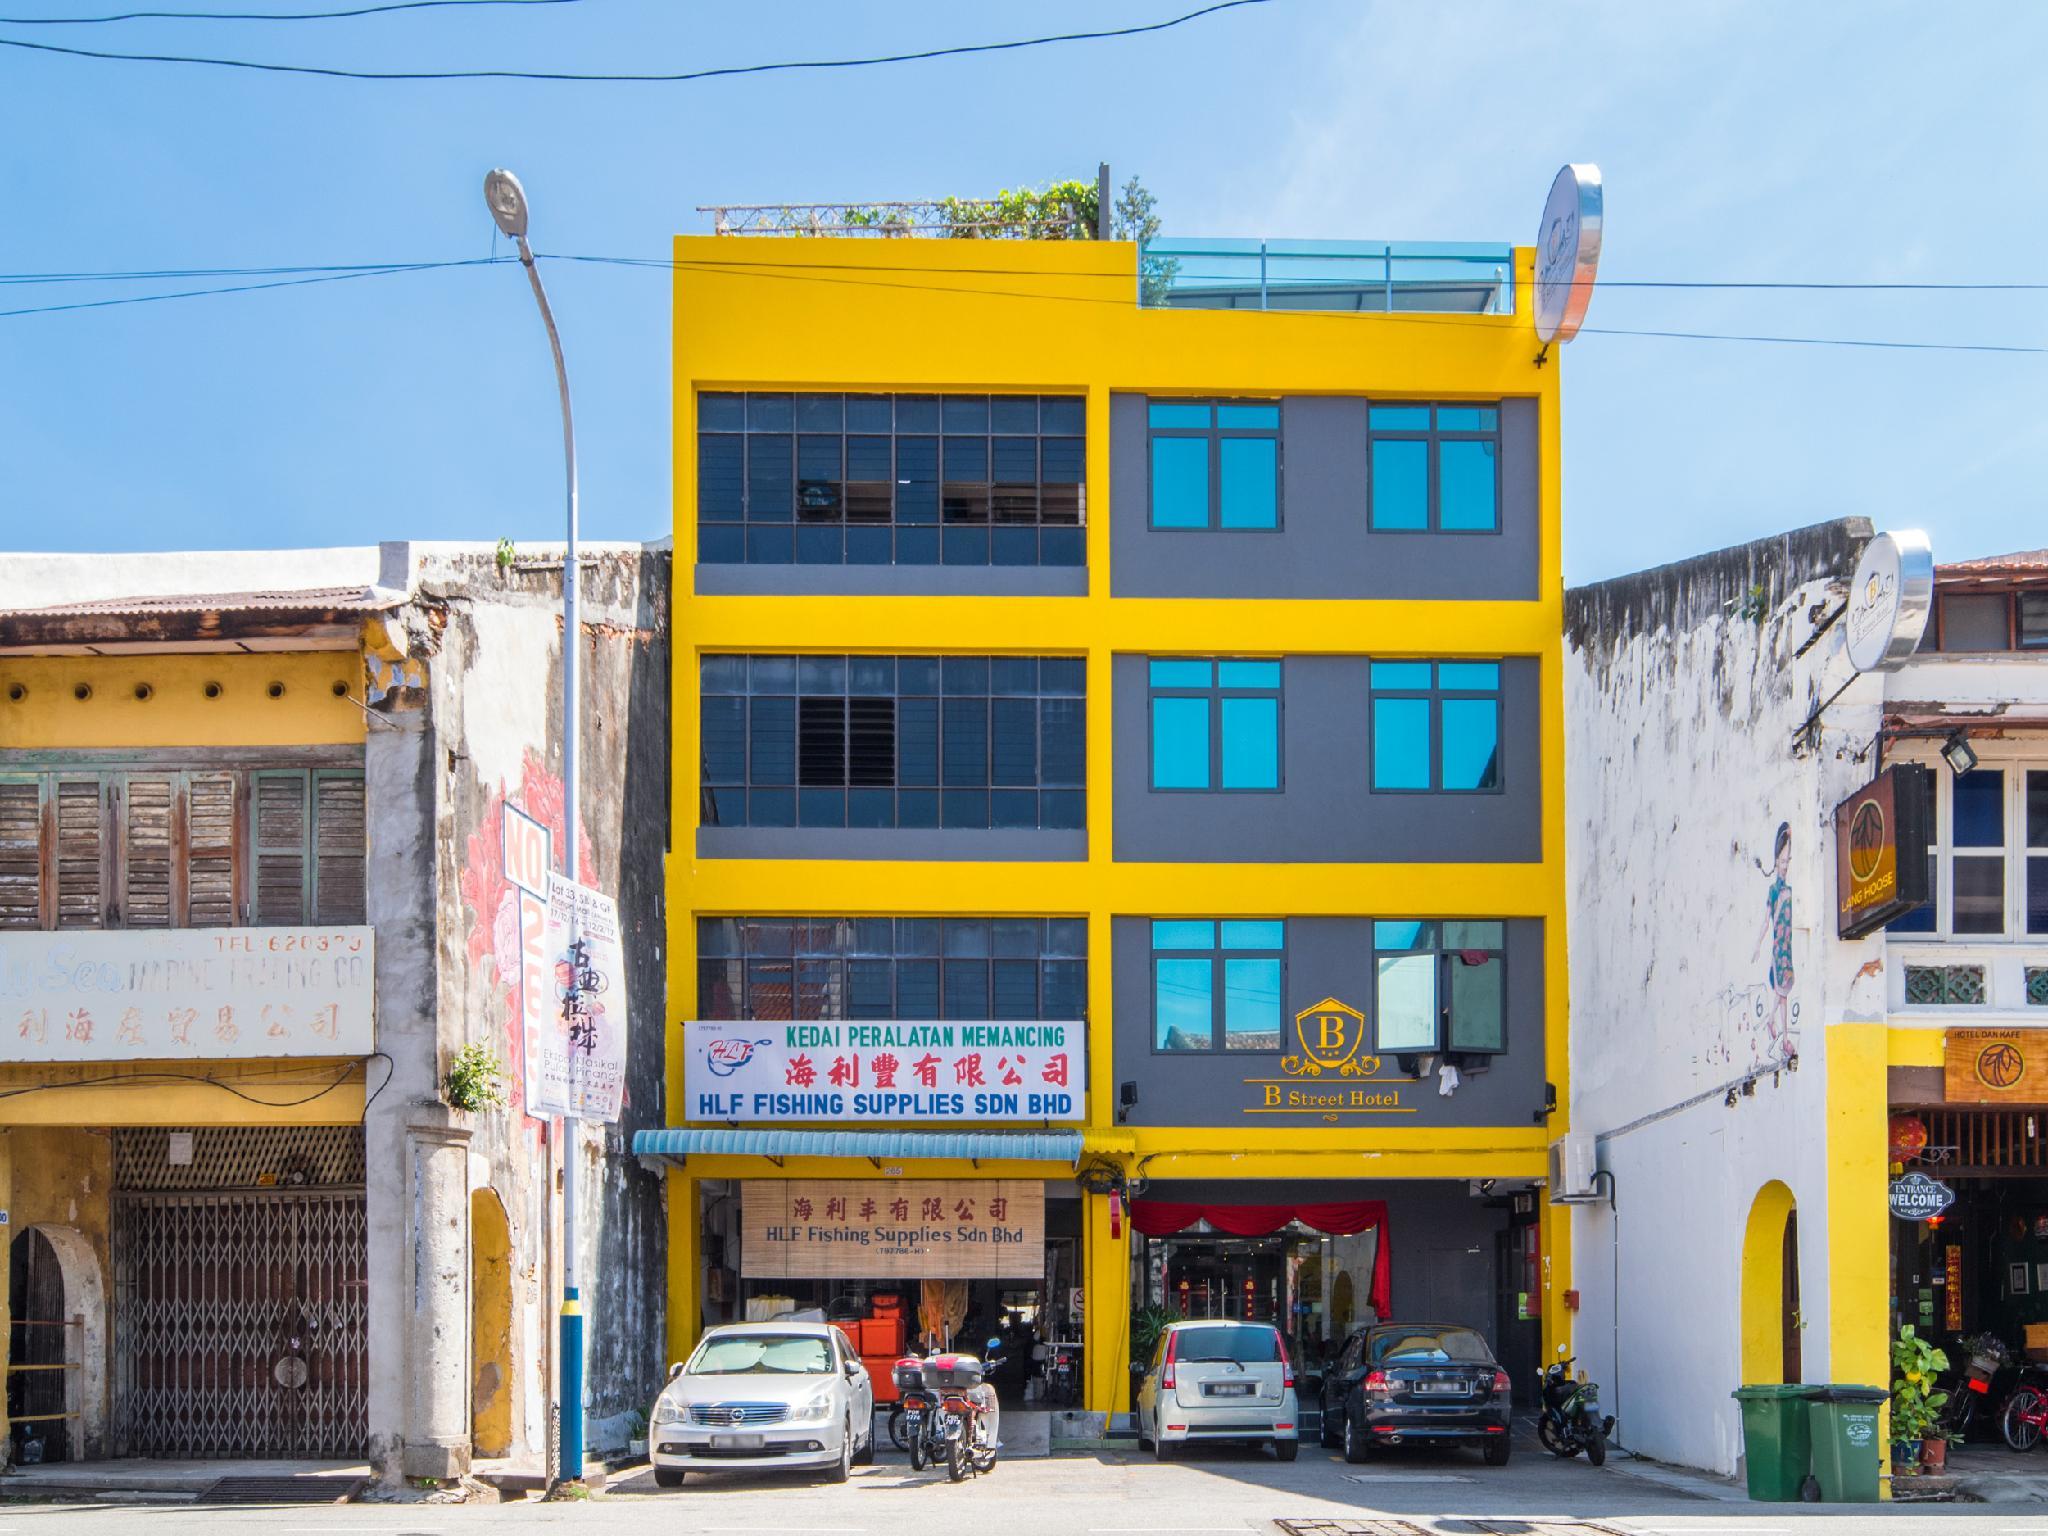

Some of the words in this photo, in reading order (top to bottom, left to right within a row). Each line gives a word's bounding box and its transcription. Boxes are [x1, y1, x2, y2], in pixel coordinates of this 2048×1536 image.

[506, 811, 542, 891] NO
[552, 881, 564, 896] Lot
[1841, 890, 1863, 913] LANG
[1864, 871, 1893, 900] HOOSE
[1755, 994, 1764, 1018] 6
[1791, 1001, 1800, 1026] 9
[786, 1026, 841, 1048] KEDAI
[850, 1026, 951, 1048] PERALATAN
[962, 1026, 1065, 1048] MEMANCING
[1316, 1015, 1345, 1049] B
[1954, 1030, 1980, 1039] HOTEL
[1981, 1031, 1998, 1039] DAN
[2000, 1030, 2021, 1039] KAFE
[699, 1093, 744, 1115] HLF
[754, 1093, 844, 1115] FISHING
[853, 1093, 965, 1115] SUPPLIES
[975, 1093, 1019, 1115] SDN
[1028, 1093, 1072, 1115] BHD
[1263, 1084, 1281, 1107] B
[1288, 1090, 1345, 1107] Street
[1350, 1090, 1400, 1107] Hotel
[1889, 1193, 1943, 1207] WELCOME
[1895, 1184, 1937, 1194] ENTRANCE
[793, 1197, 1009, 1222] 海利丰有限公司
[766, 1226, 802, 1242] HLF
[808, 1226, 870, 1245] Fishing
[874, 1226, 952, 1247] Supplies
[956, 1226, 988, 1243] Sdn
[992, 1226, 1023, 1243] Bhd
